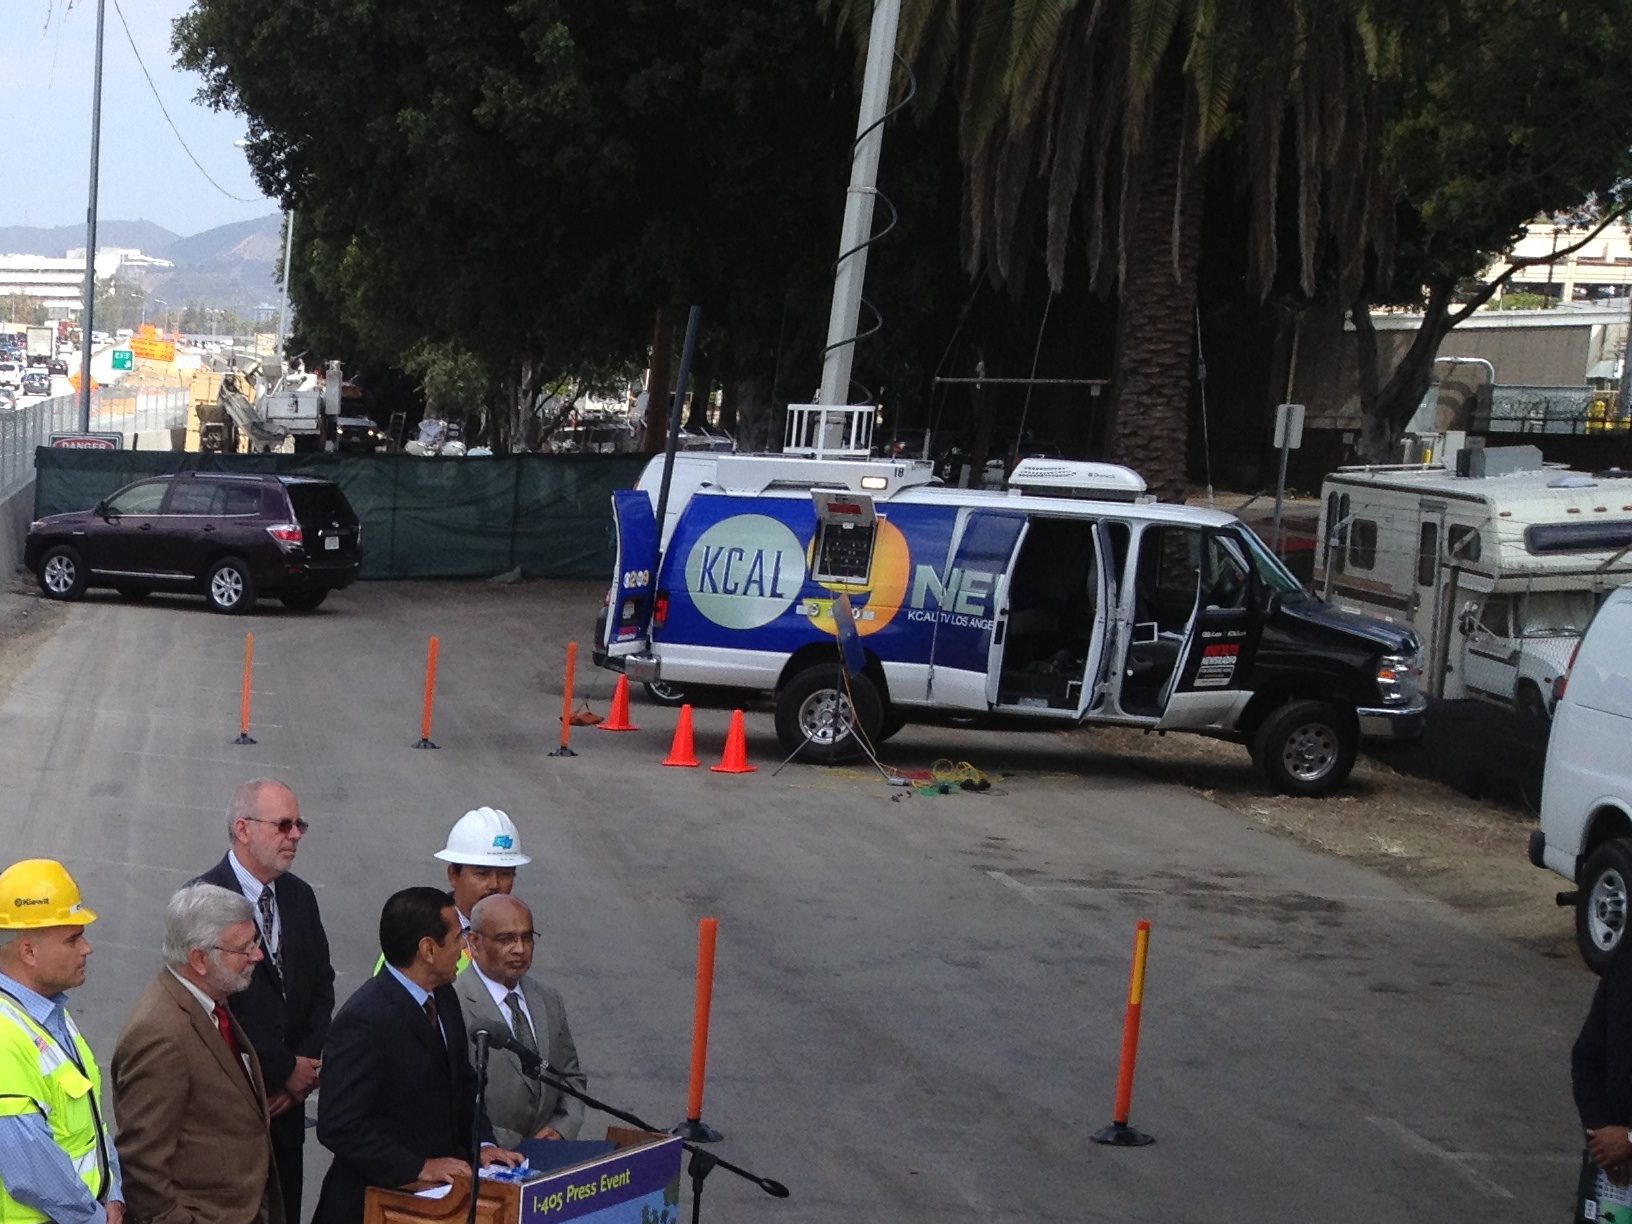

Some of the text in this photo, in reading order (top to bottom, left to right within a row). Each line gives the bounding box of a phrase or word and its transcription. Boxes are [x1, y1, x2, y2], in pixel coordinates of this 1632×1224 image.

[894, 467, 904, 477] 18
[698, 545, 785, 599] KCAL
[908, 610, 937, 623] KCAL
[951, 614, 968, 627] LOS
[969, 618, 995, 631] ANGE
[533, 1168, 630, 1215] I-405 Press Event
